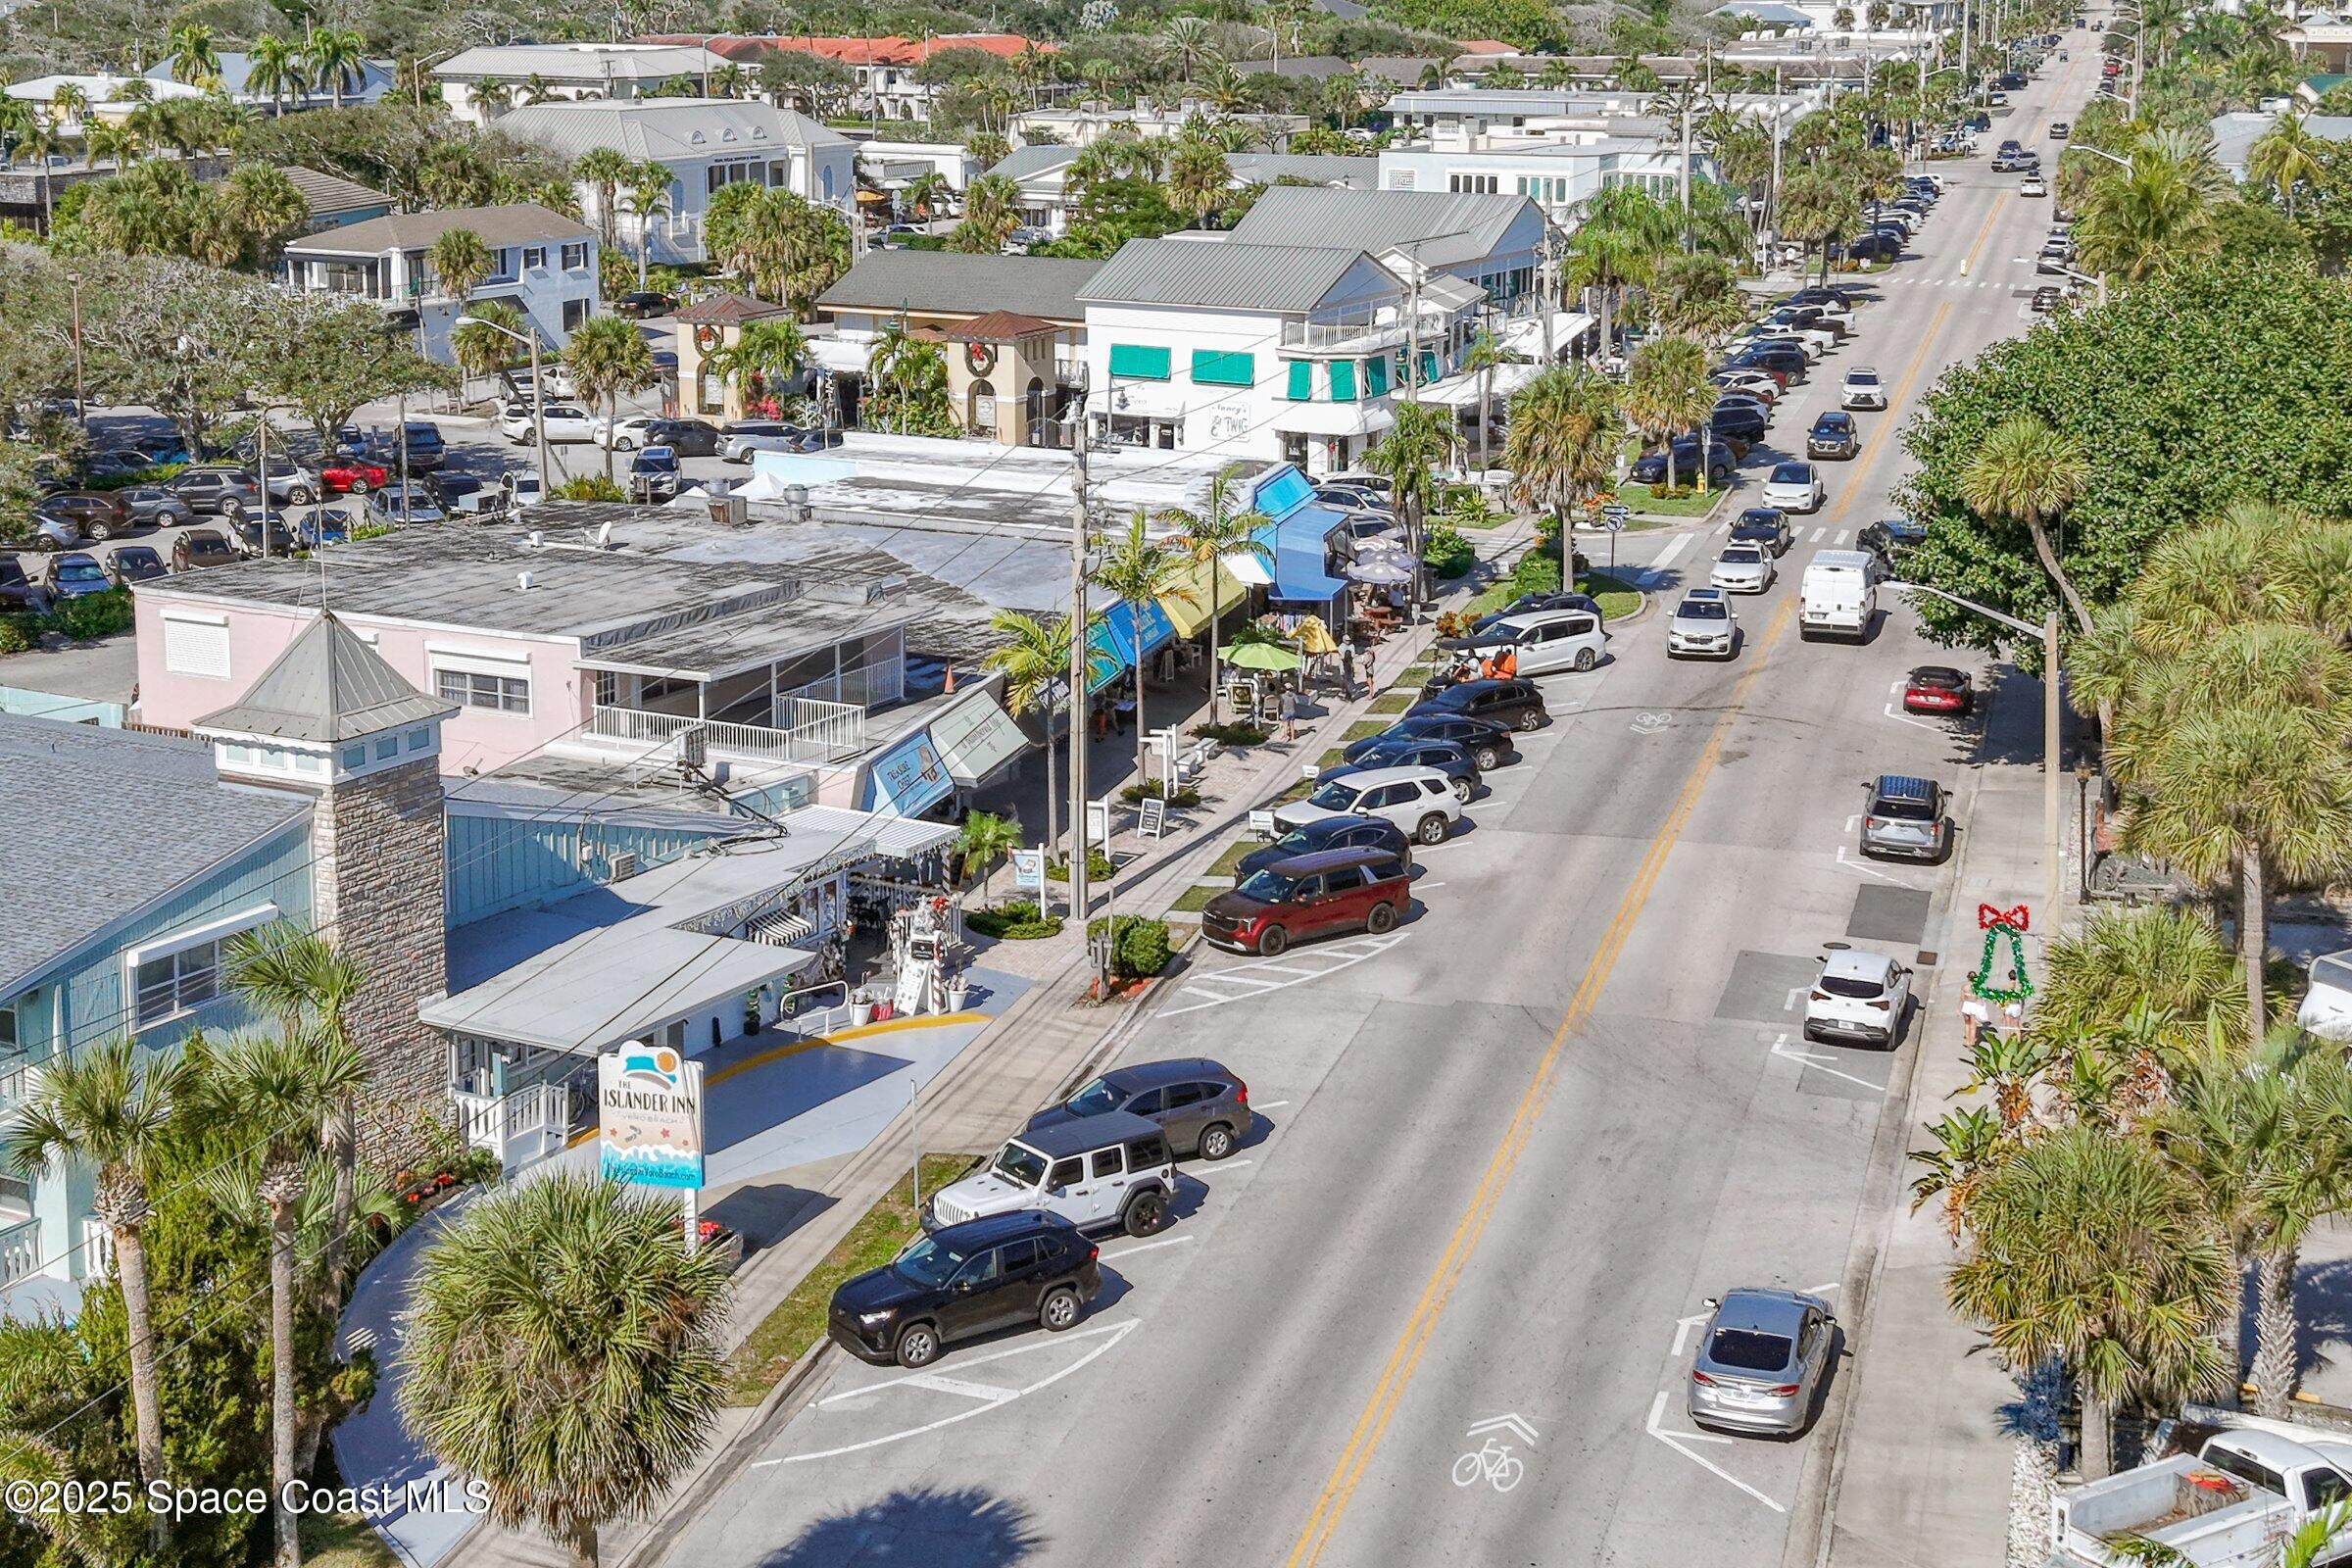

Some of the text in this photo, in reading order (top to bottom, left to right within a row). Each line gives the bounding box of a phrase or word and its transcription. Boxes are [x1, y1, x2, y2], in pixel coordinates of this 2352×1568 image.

[887, 760, 910, 781] TREASURE
[618, 1080, 631, 1089] THE
[604, 1089, 696, 1113] ISLANDER INN
